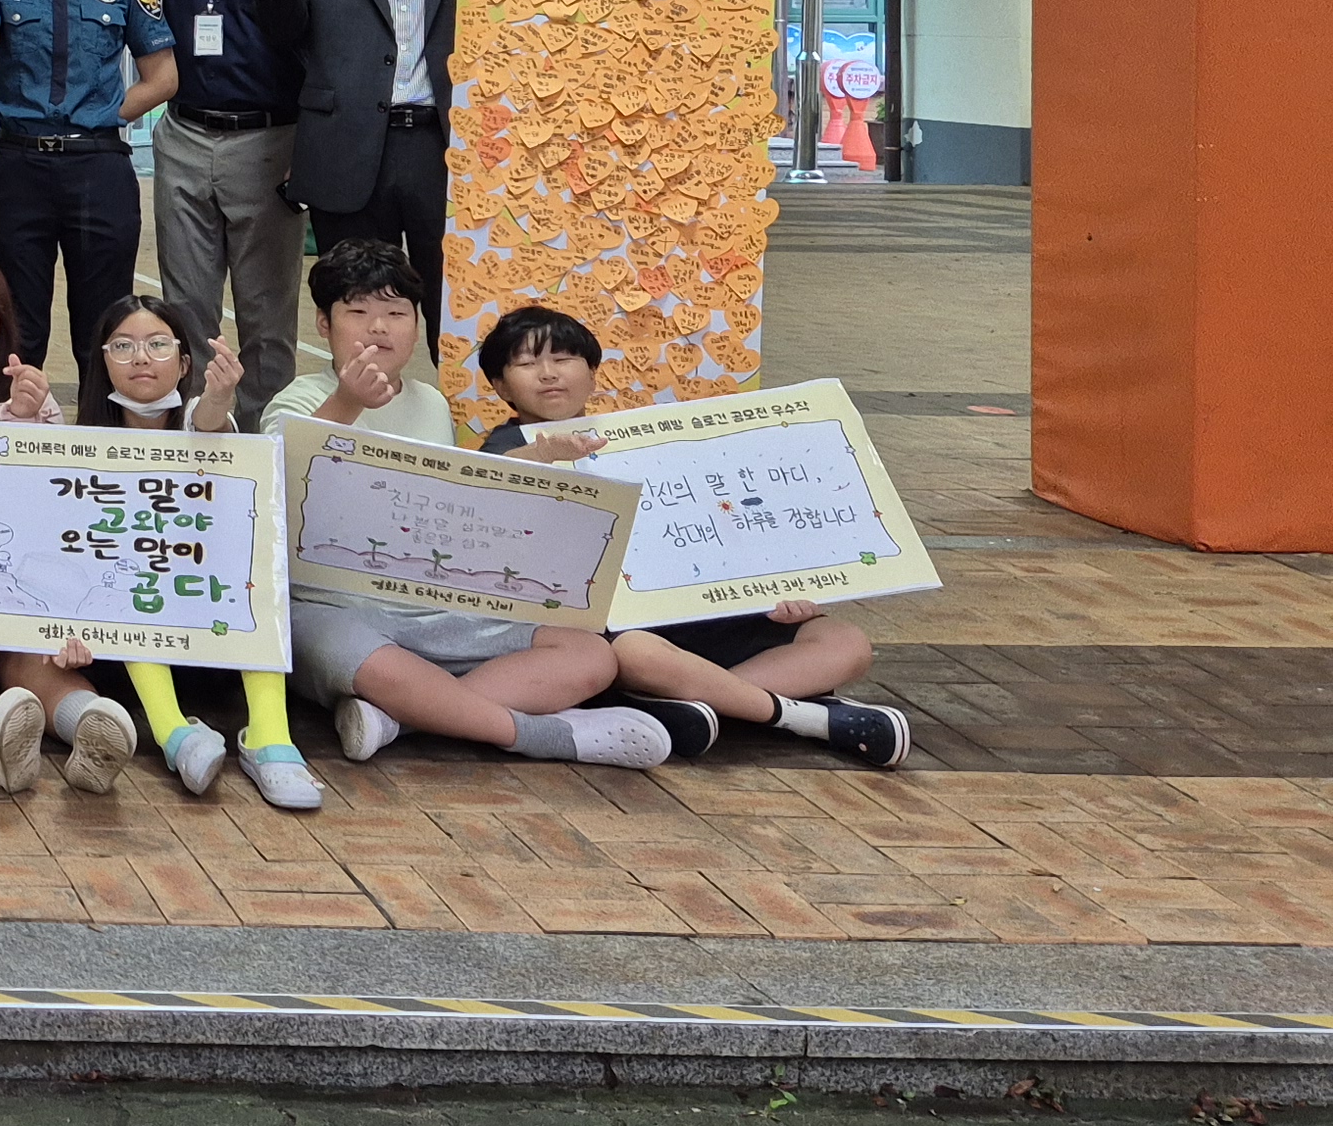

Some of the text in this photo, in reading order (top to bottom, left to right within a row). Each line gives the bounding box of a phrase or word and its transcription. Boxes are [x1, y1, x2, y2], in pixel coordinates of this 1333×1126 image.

[846, 74, 877, 85] 주차금지
[604, 401, 809, 441] 언어폭력 예방 슬로건 공모전 우수작
[50, 475, 214, 514] 가는 말이
[705, 472, 730, 497] 말
[738, 467, 758, 492] 한
[89, 507, 214, 534] 고와야
[662, 506, 857, 548] 상대의 하루를 정합니다
[60, 530, 204, 573] 오는 말이
[702, 572, 849, 603] 영화초 6학년 3반 정의산
